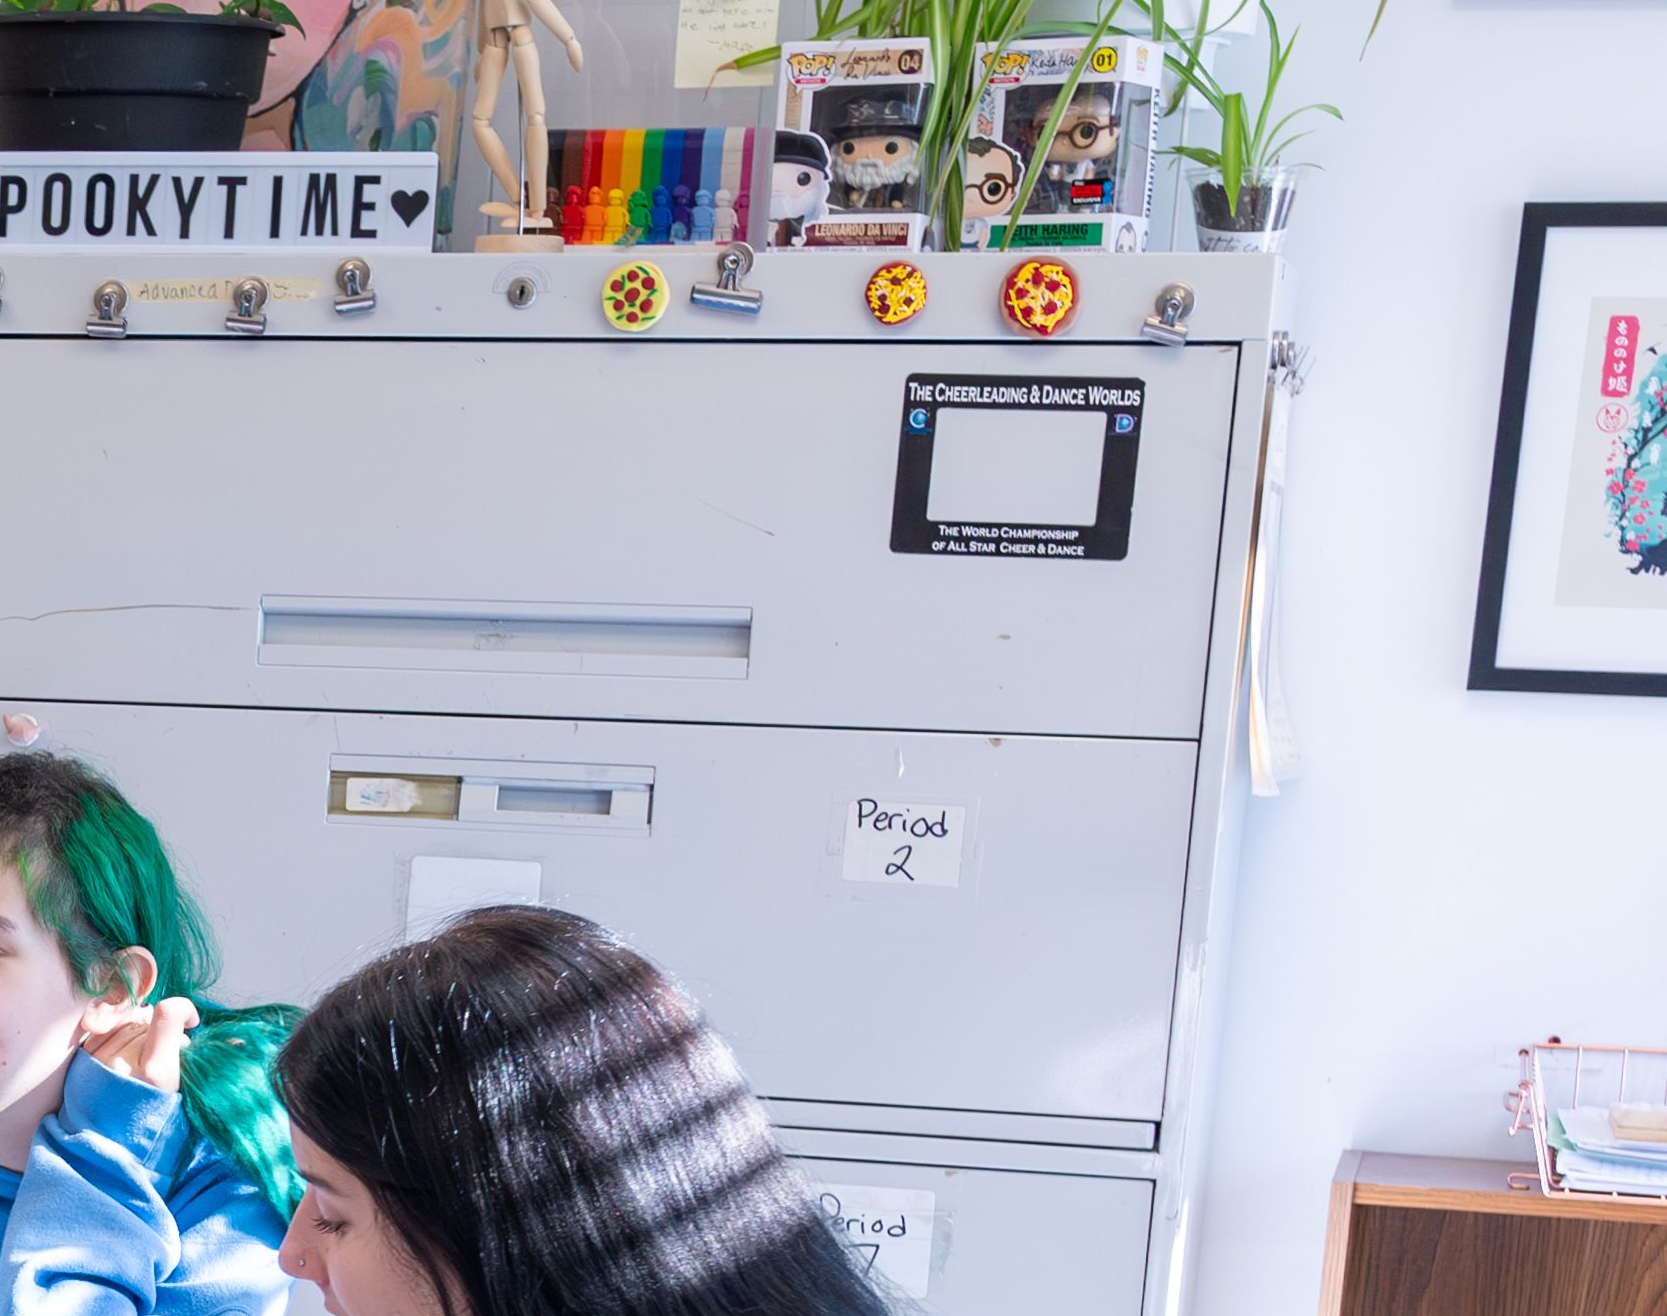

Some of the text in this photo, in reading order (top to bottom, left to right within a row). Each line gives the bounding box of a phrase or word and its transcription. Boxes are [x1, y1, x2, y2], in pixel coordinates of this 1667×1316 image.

[788, 53, 836, 77] POP!
[900, 54, 921, 71] 04
[1096, 54, 1113, 67] 01
[814, 222, 908, 236] LEONARDO DA VINCI
[1003, 223, 1089, 237] EITH HARING
[908, 382, 1141, 406] THE CHEERLEADING & DANCE WORLDS
[938, 524, 1079, 541] THE WORLD CHAMPIONSHIP
[947, 541, 968, 552] ALL
[969, 541, 996, 553] STAR
[1000, 542, 1036, 555] CHEER
[1037, 543, 1046, 555] &
[1048, 543, 1085, 556] DANCE
[857, 798, 949, 838] Period
[885, 844, 915, 881] 2
[846, 1243, 880, 1276] 7
